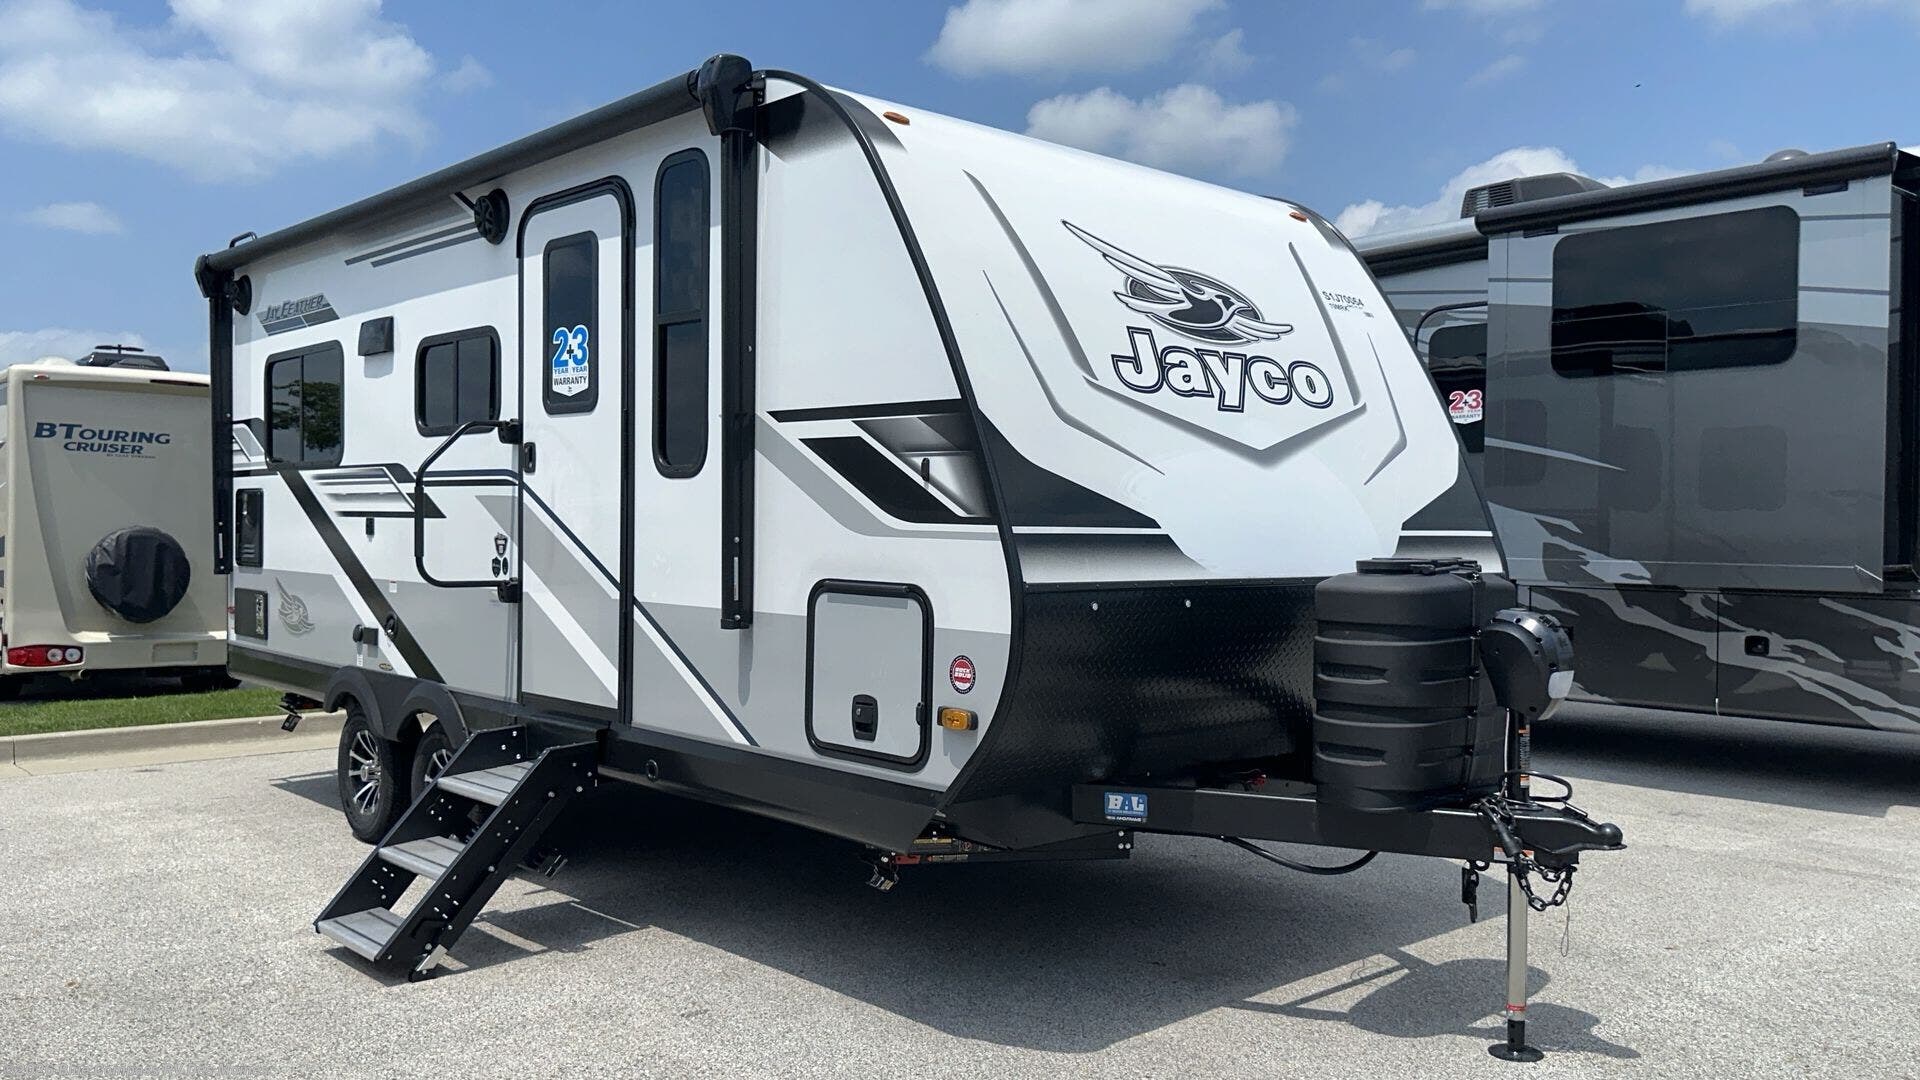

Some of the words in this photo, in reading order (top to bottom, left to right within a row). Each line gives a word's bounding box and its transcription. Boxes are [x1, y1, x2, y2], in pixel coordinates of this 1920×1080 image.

[1111, 325, 1334, 413] Jayco
[554, 376, 587, 386] WARRANTY
[63, 441, 144, 454] CRUISER
